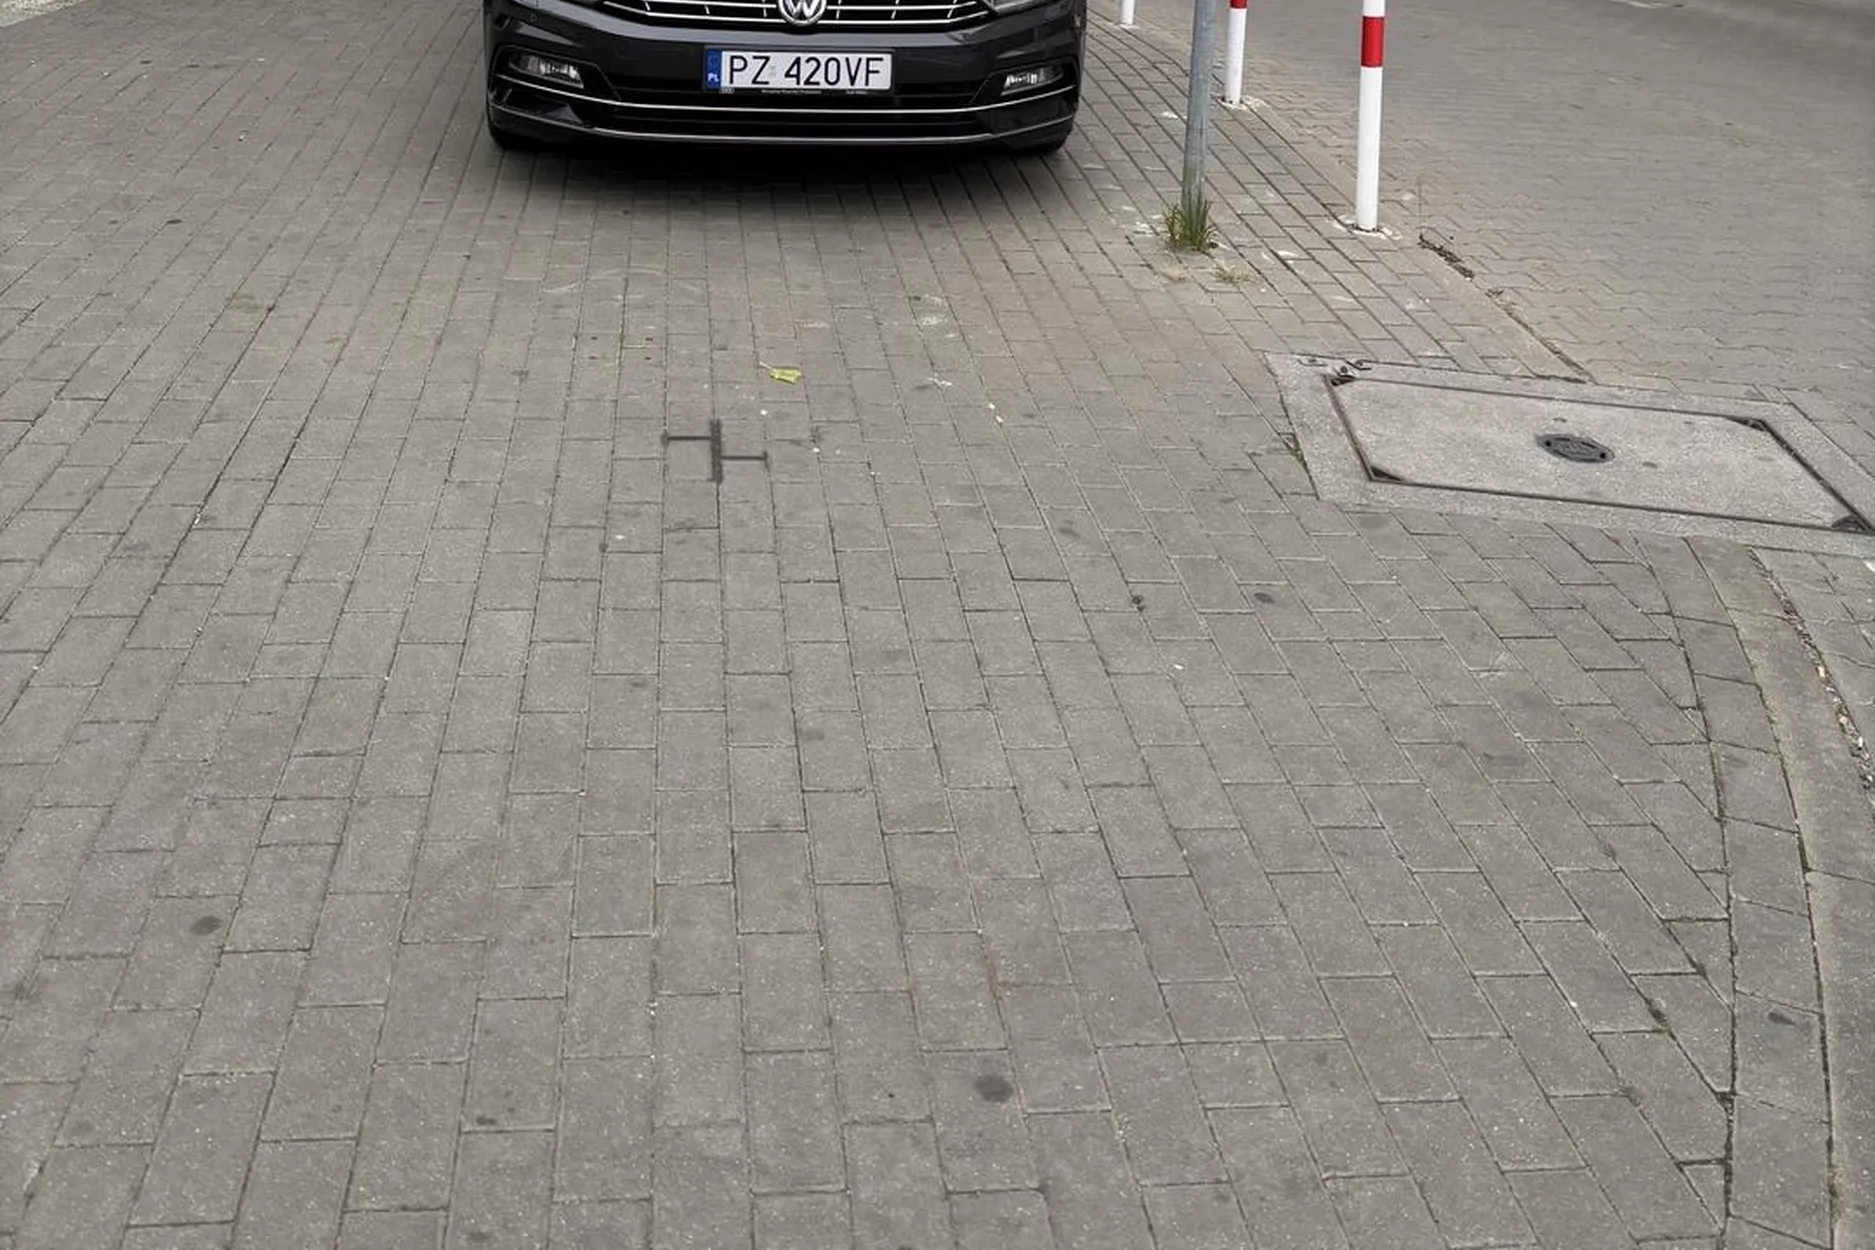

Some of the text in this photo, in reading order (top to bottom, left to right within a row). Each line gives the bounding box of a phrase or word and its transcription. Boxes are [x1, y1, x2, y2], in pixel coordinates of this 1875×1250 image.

[707, 72, 719, 82] PL
[729, 55, 884, 86] PZ 420VF
